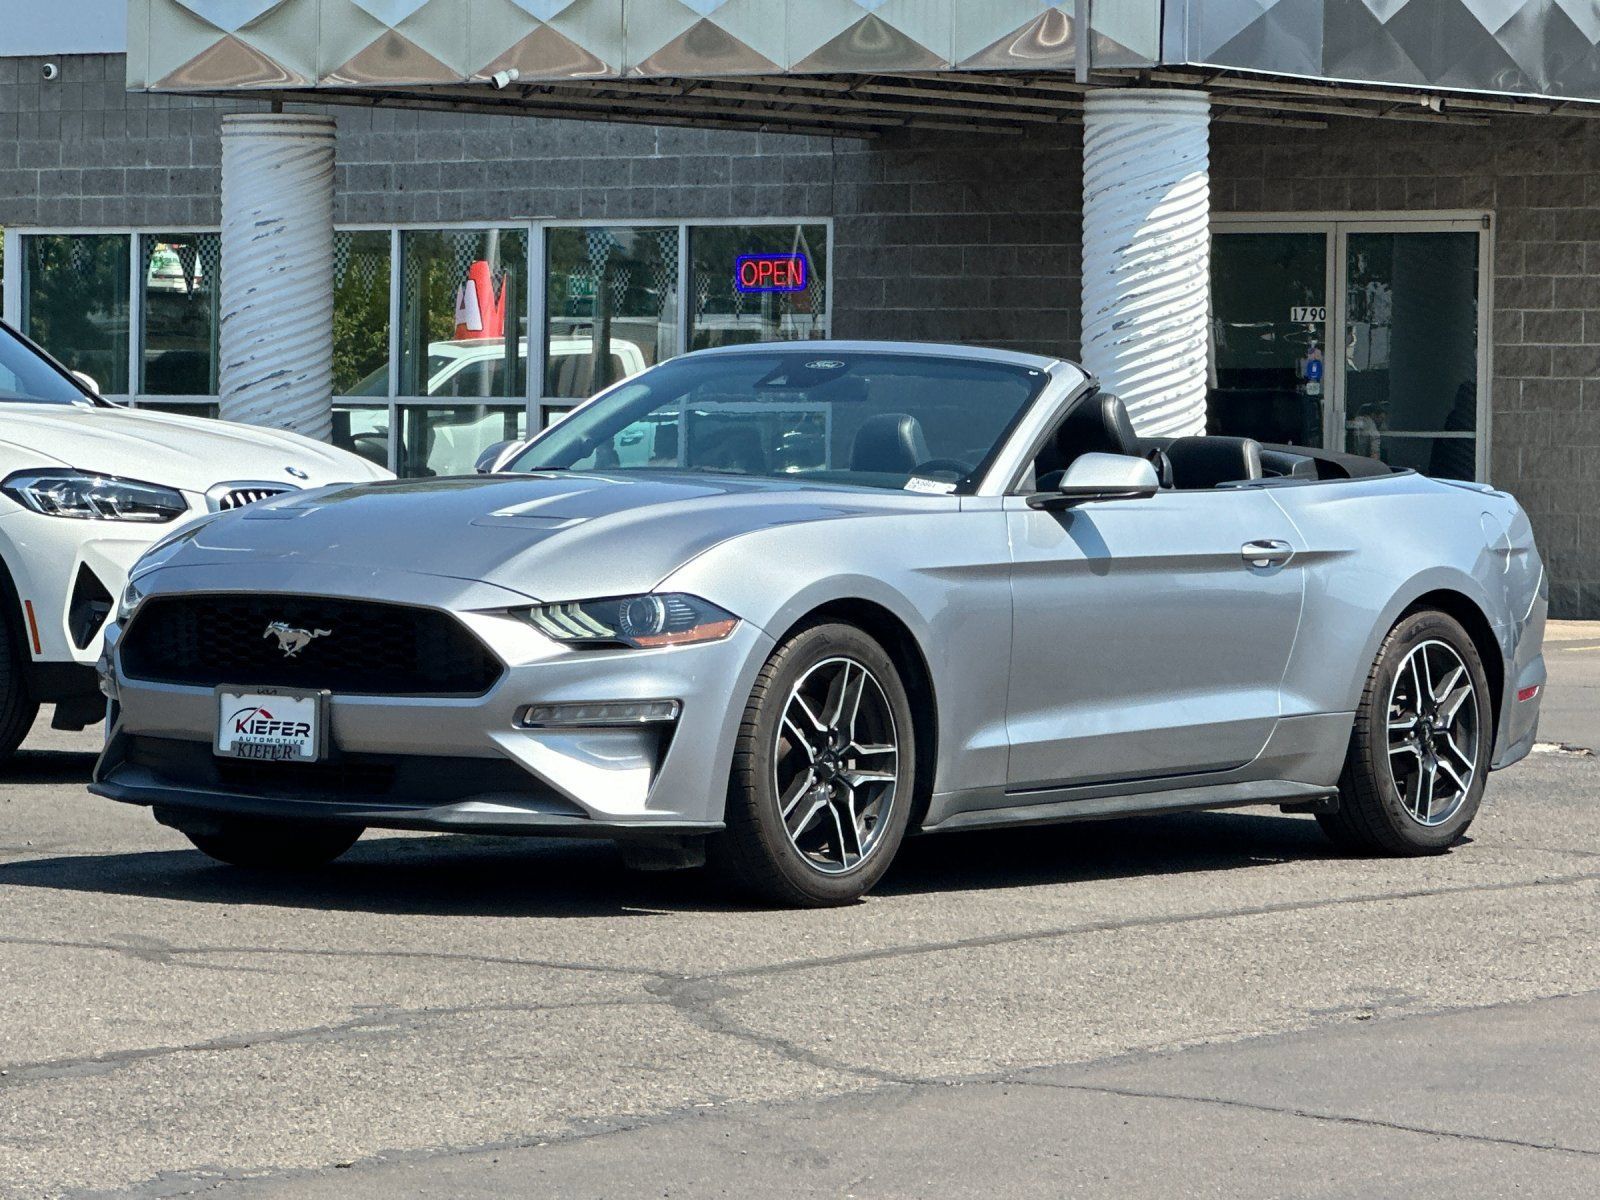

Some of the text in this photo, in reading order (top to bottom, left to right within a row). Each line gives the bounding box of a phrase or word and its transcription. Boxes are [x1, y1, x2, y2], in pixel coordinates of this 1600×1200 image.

[741, 261, 803, 286] OPEN
[1293, 308, 1326, 321] 1790
[235, 719, 310, 737] KIEFER
[238, 736, 305, 746] AUTOMOTIVE
[237, 742, 292, 759] KIEFER
